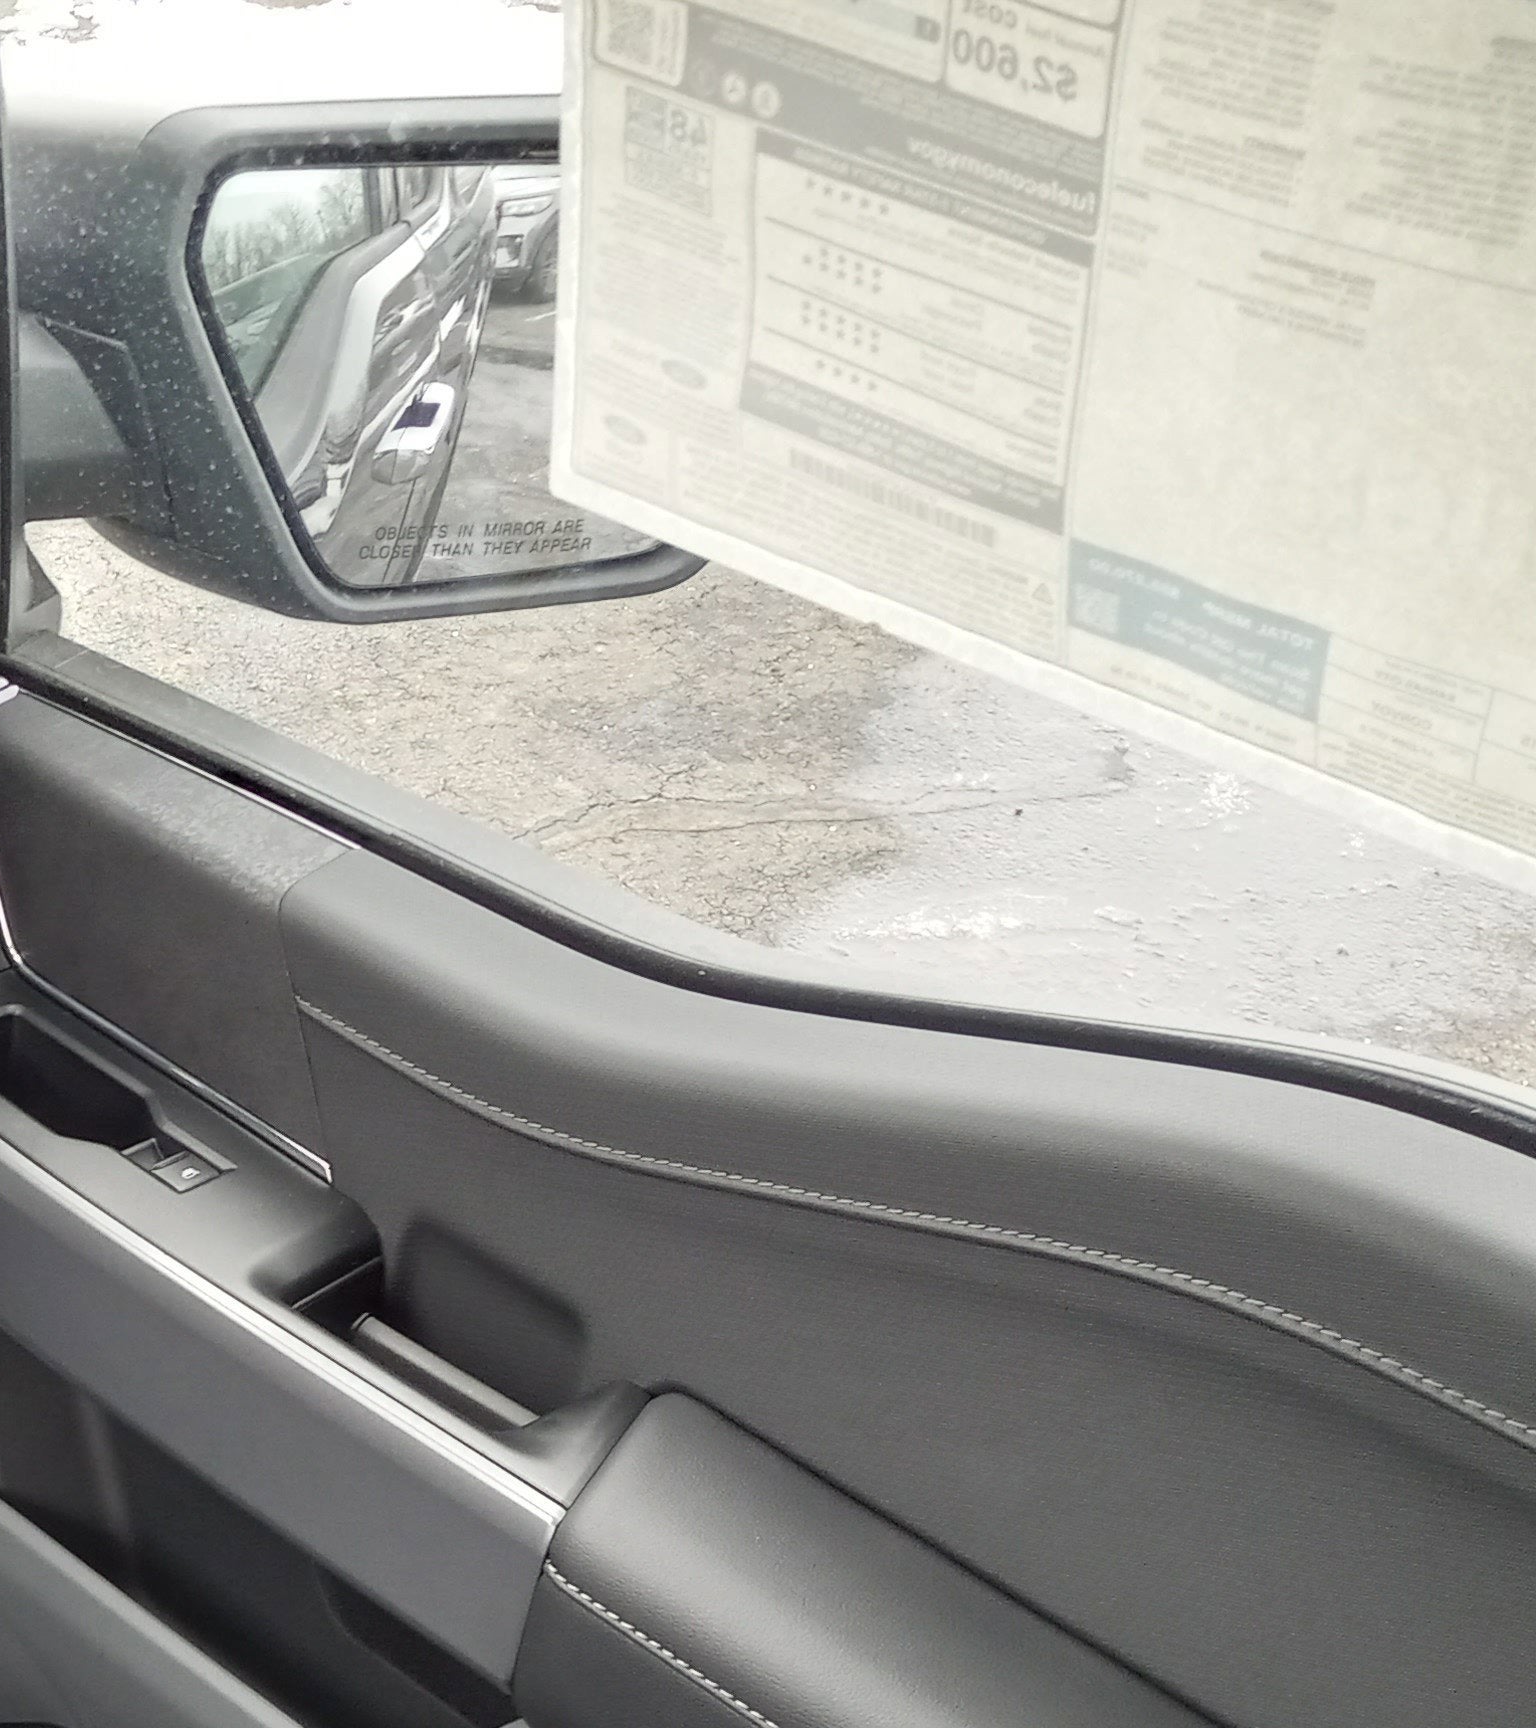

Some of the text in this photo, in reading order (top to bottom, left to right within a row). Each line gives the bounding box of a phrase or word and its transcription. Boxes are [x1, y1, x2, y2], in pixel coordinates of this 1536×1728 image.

[458, 522, 475, 538] IN
[483, 521, 546, 537] MIRROR
[552, 519, 585, 534] ARE
[432, 542, 474, 557] THAN
[483, 540, 524, 556] THEY
[529, 537, 592, 554] APPEAR
